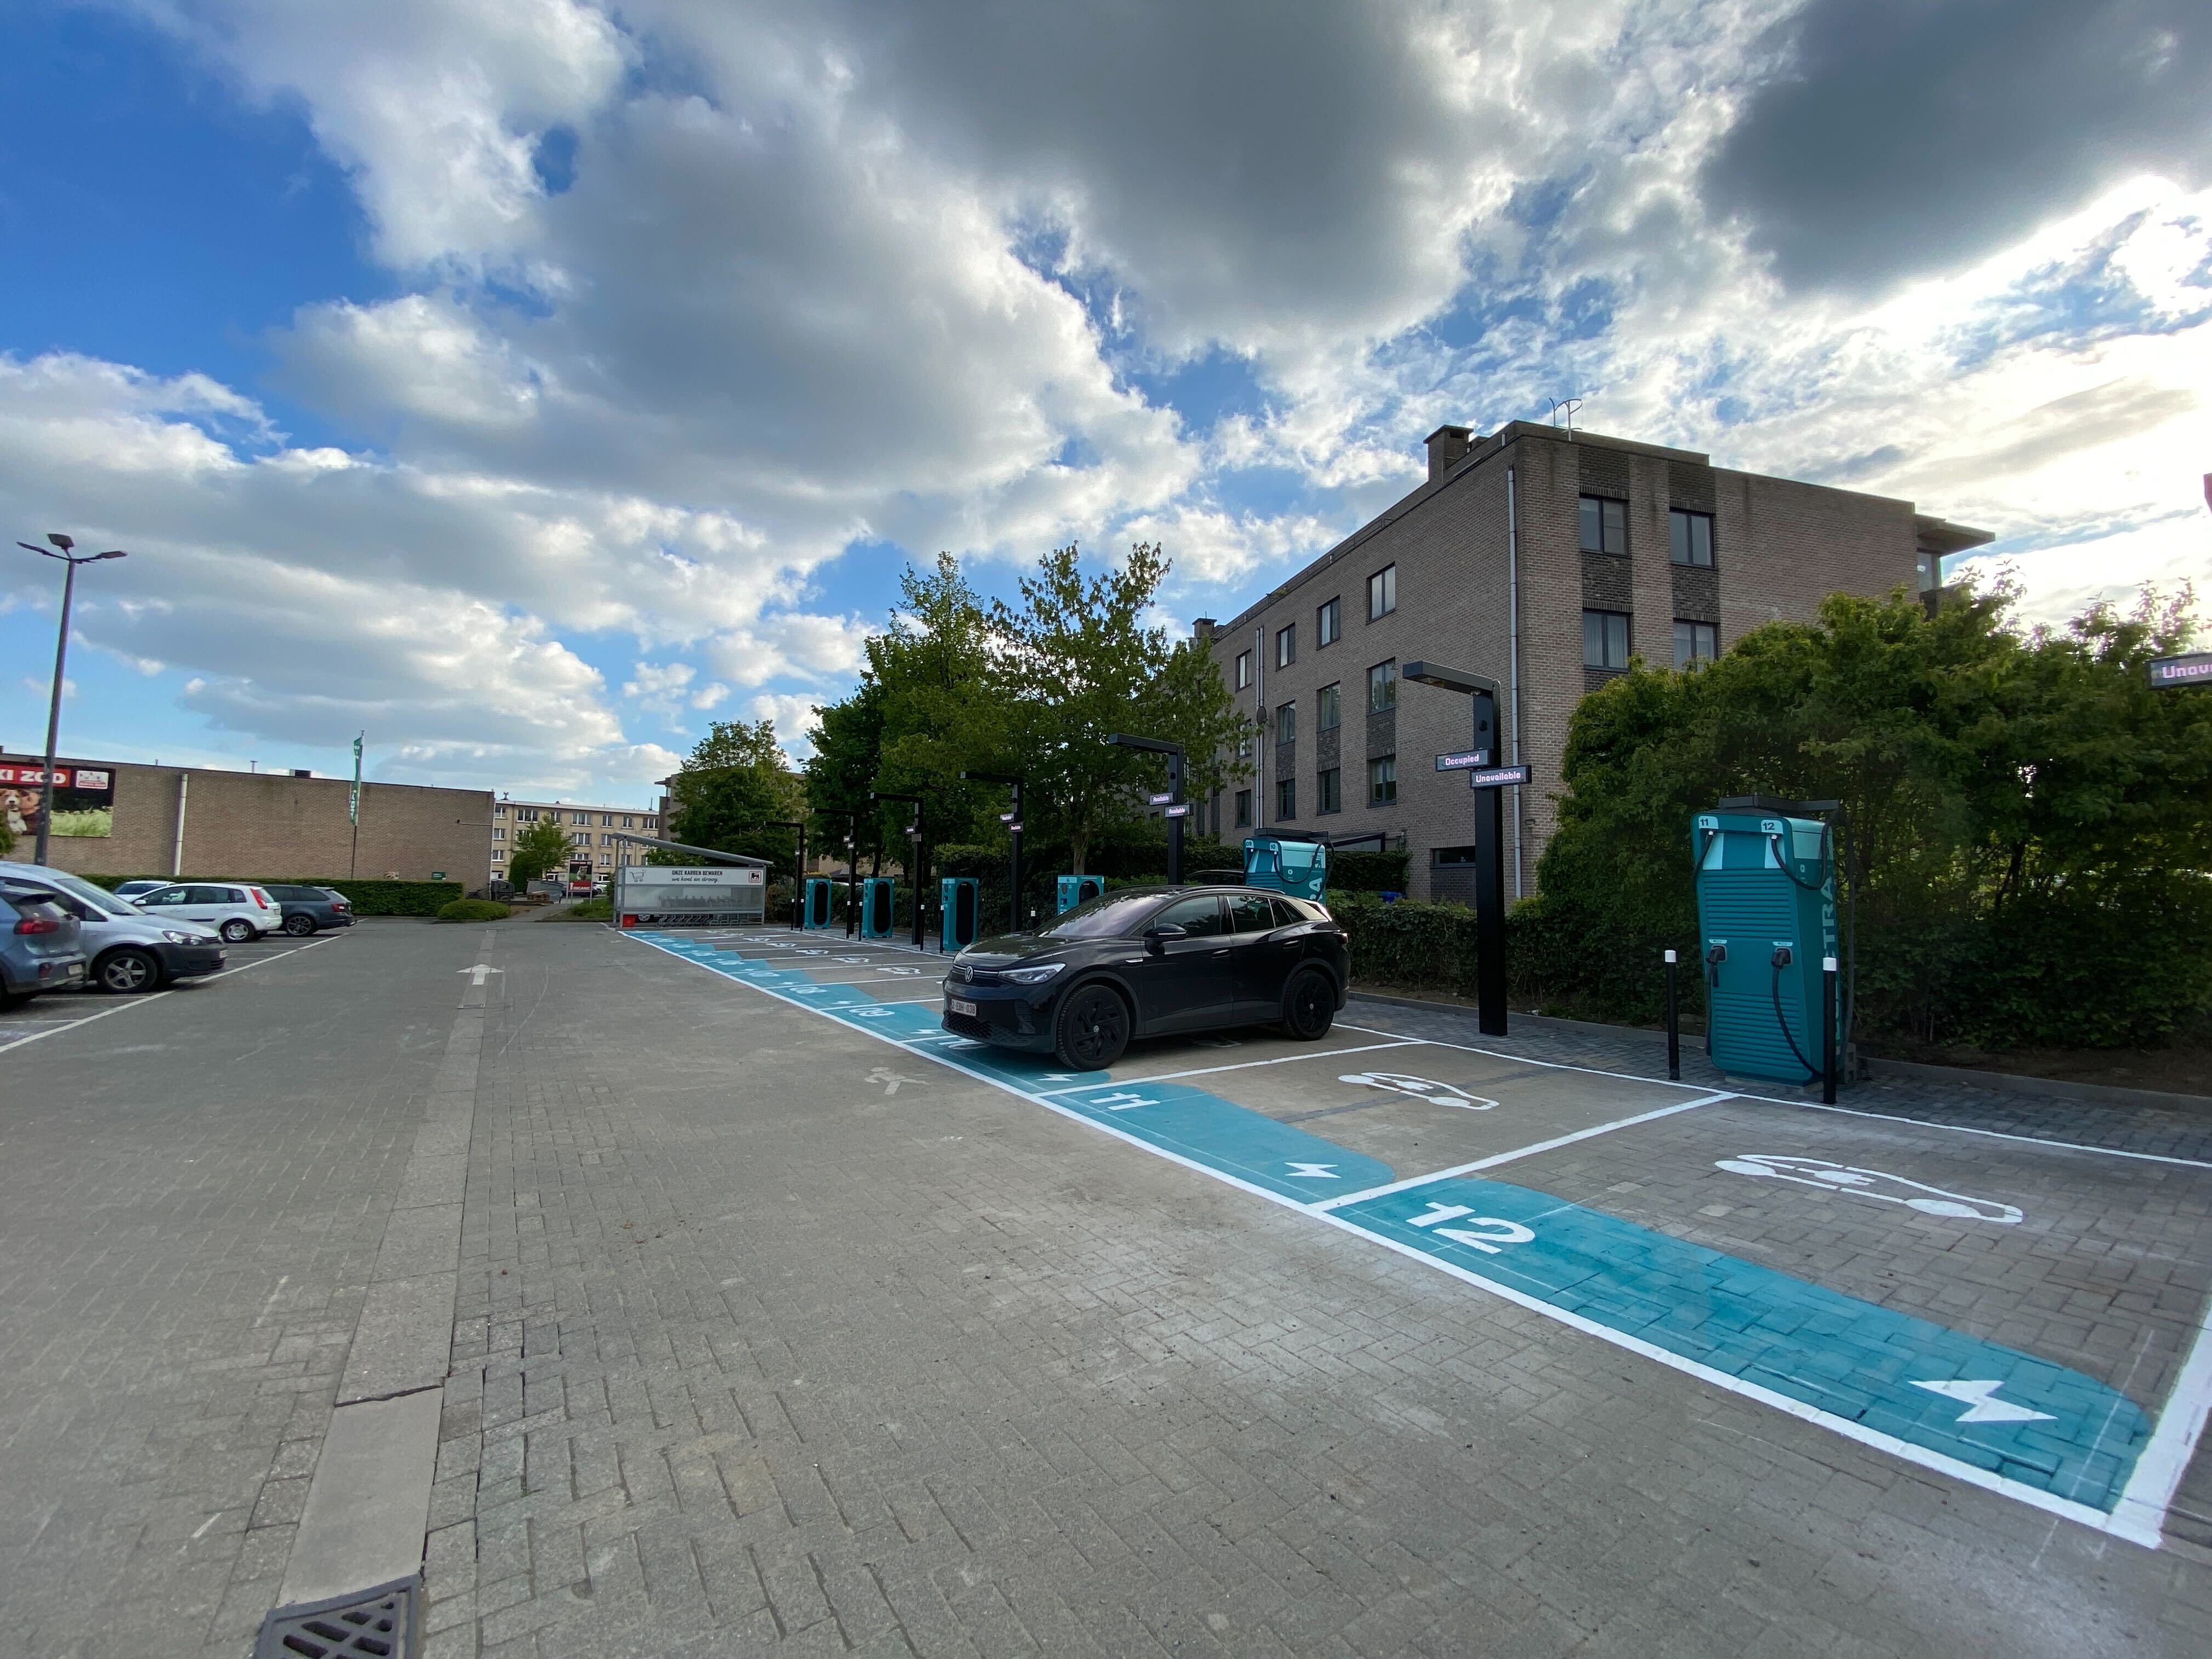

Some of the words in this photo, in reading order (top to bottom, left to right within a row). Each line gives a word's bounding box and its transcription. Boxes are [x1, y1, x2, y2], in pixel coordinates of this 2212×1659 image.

[2162, 664, 2212, 679] Unav
[1445, 754, 1480, 766] Occupied
[1476, 771, 1521, 783] Unavailable
[1700, 818, 1709, 826] 11
[1762, 822, 1775, 831] 12
[1089, 1092, 1160, 1110] 11
[1405, 1201, 1536, 1255] 12
